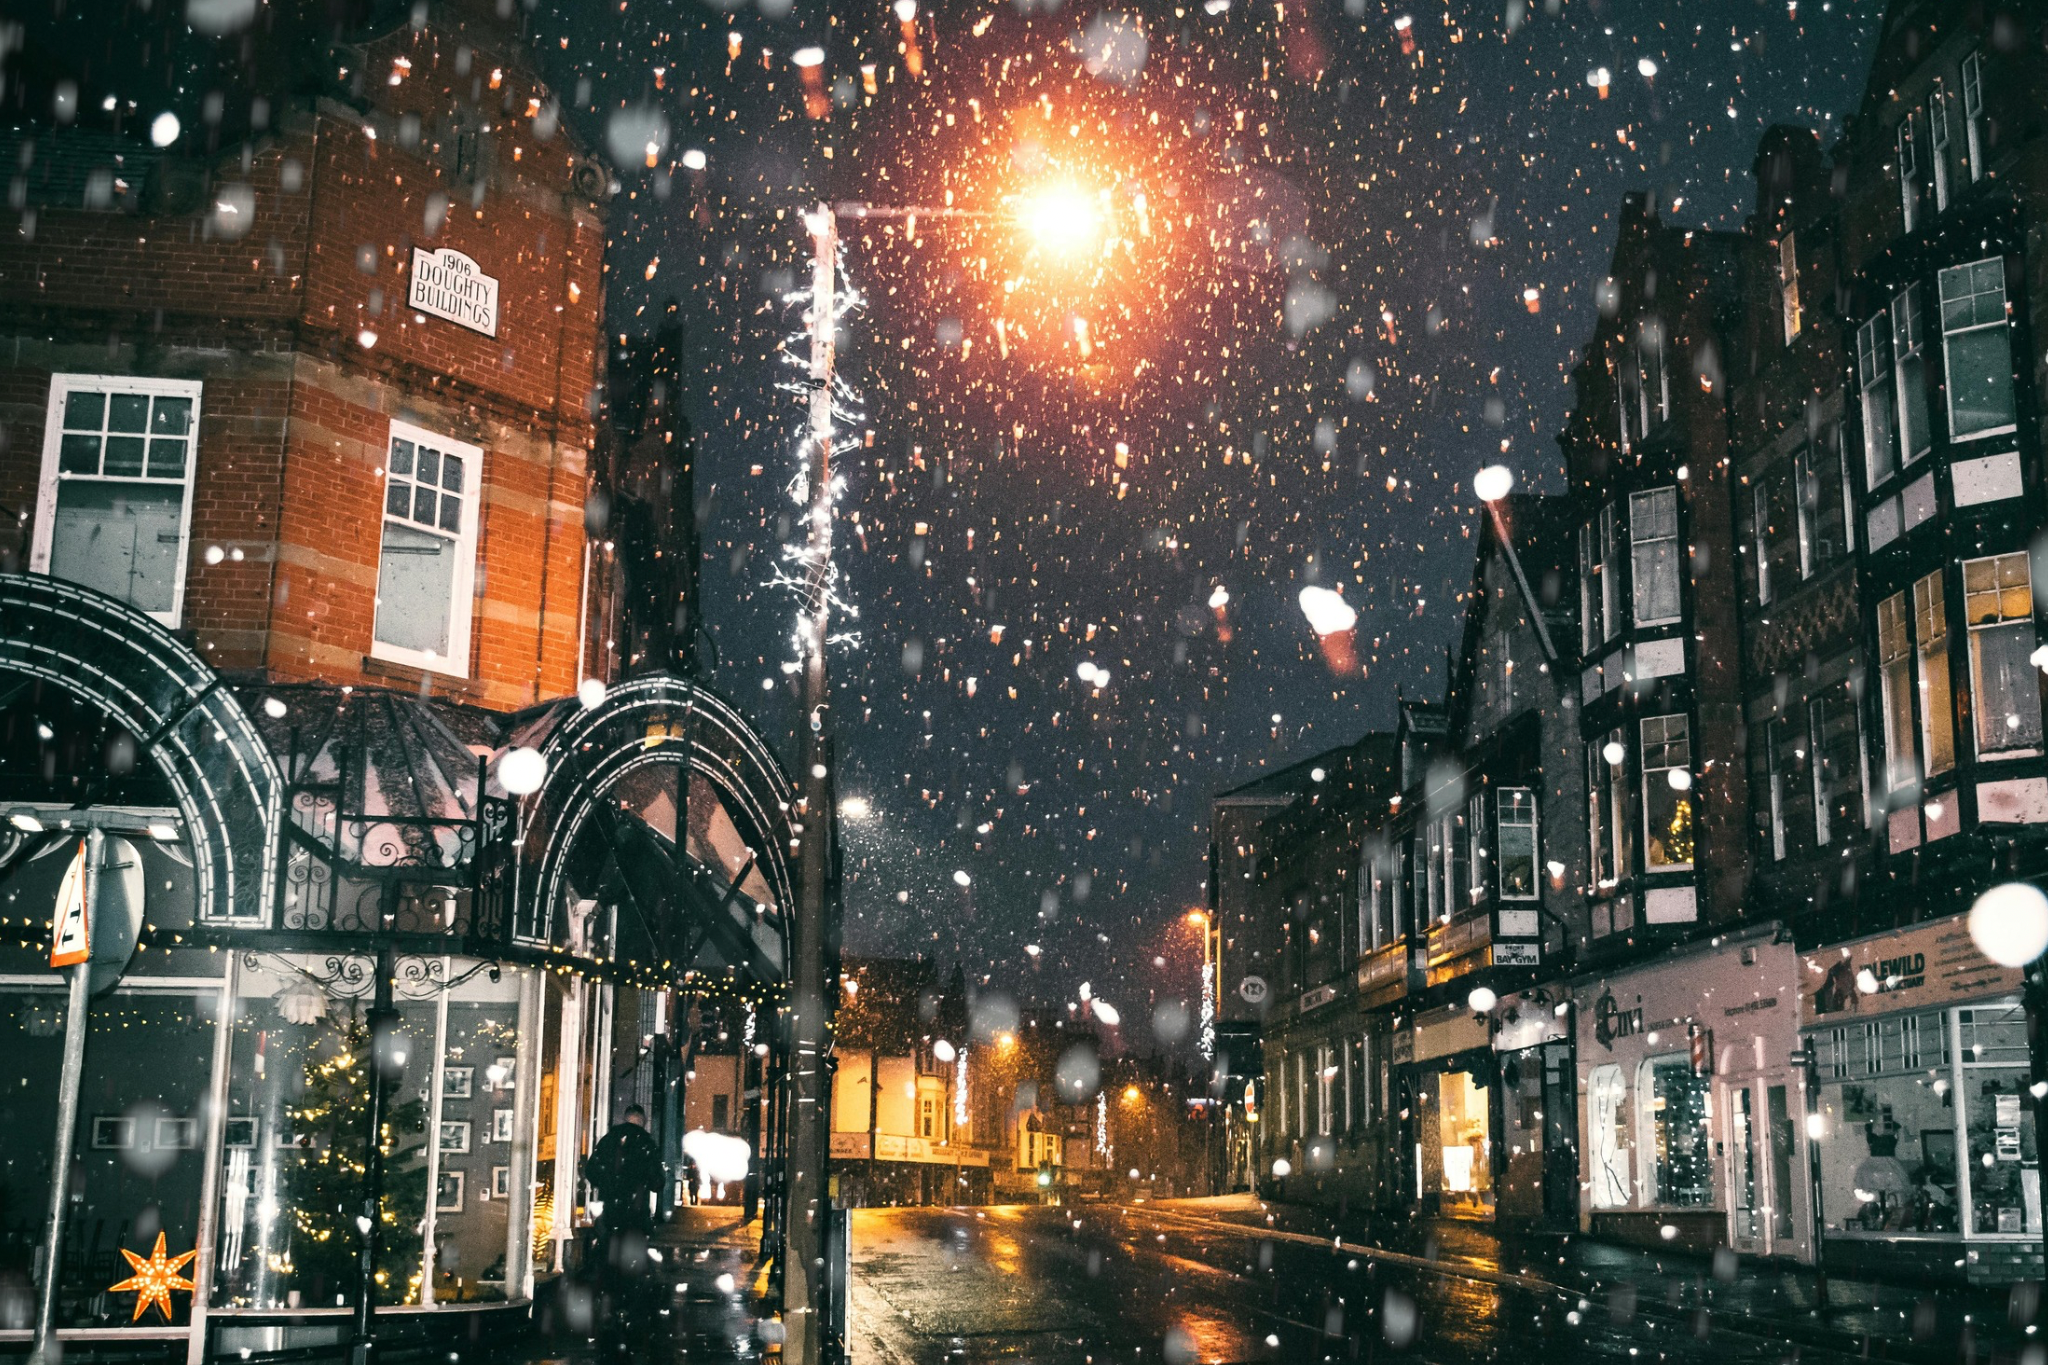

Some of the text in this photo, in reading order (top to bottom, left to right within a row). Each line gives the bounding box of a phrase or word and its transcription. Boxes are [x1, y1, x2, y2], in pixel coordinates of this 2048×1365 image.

[419, 260, 491, 305] DOUGHTY
[443, 254, 471, 277] 1906
[415, 281, 491, 328] BUILDINGS
[1496, 955, 1537, 964] BAY GYM
